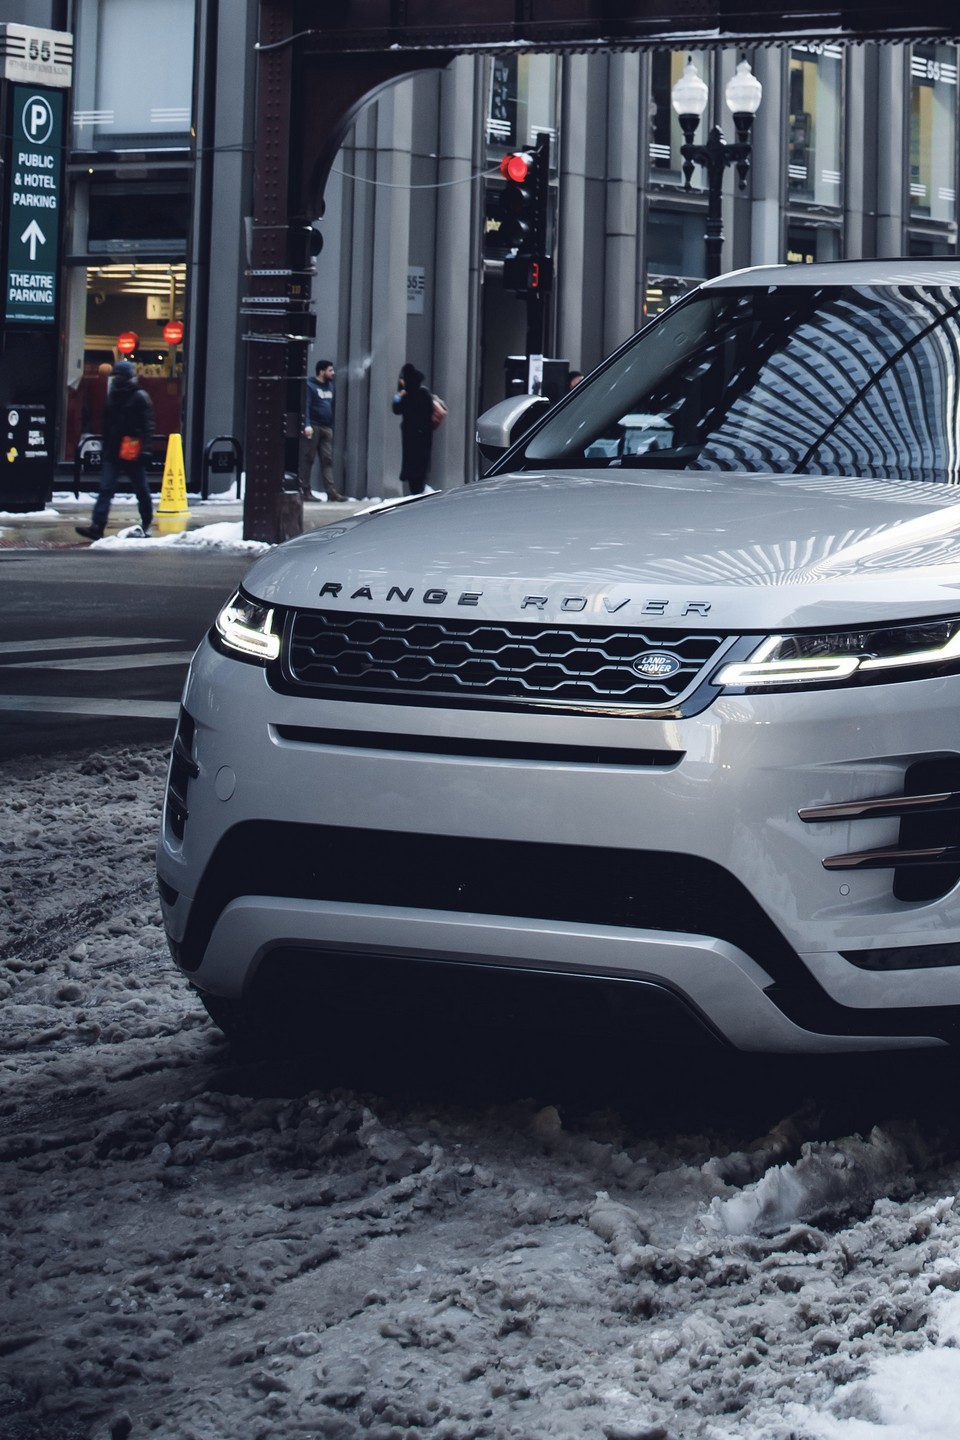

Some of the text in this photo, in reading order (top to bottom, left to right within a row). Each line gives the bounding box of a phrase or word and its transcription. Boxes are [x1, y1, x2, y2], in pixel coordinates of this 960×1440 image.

[28, 38, 51, 63] 55
[926, 59, 941, 81] 55
[30, 103, 48, 135] P
[18, 152, 55, 169] PUBLIC
[14, 172, 57, 189] & HOTEL
[12, 192, 57, 209] PARKING
[10, 273, 54, 289] THEATRE
[9, 289, 53, 304] PARKING
[318, 581, 713, 618] RANGE ROVER
[641, 656, 667, 664] LAND
[641, 663, 672, 673] ROVER
